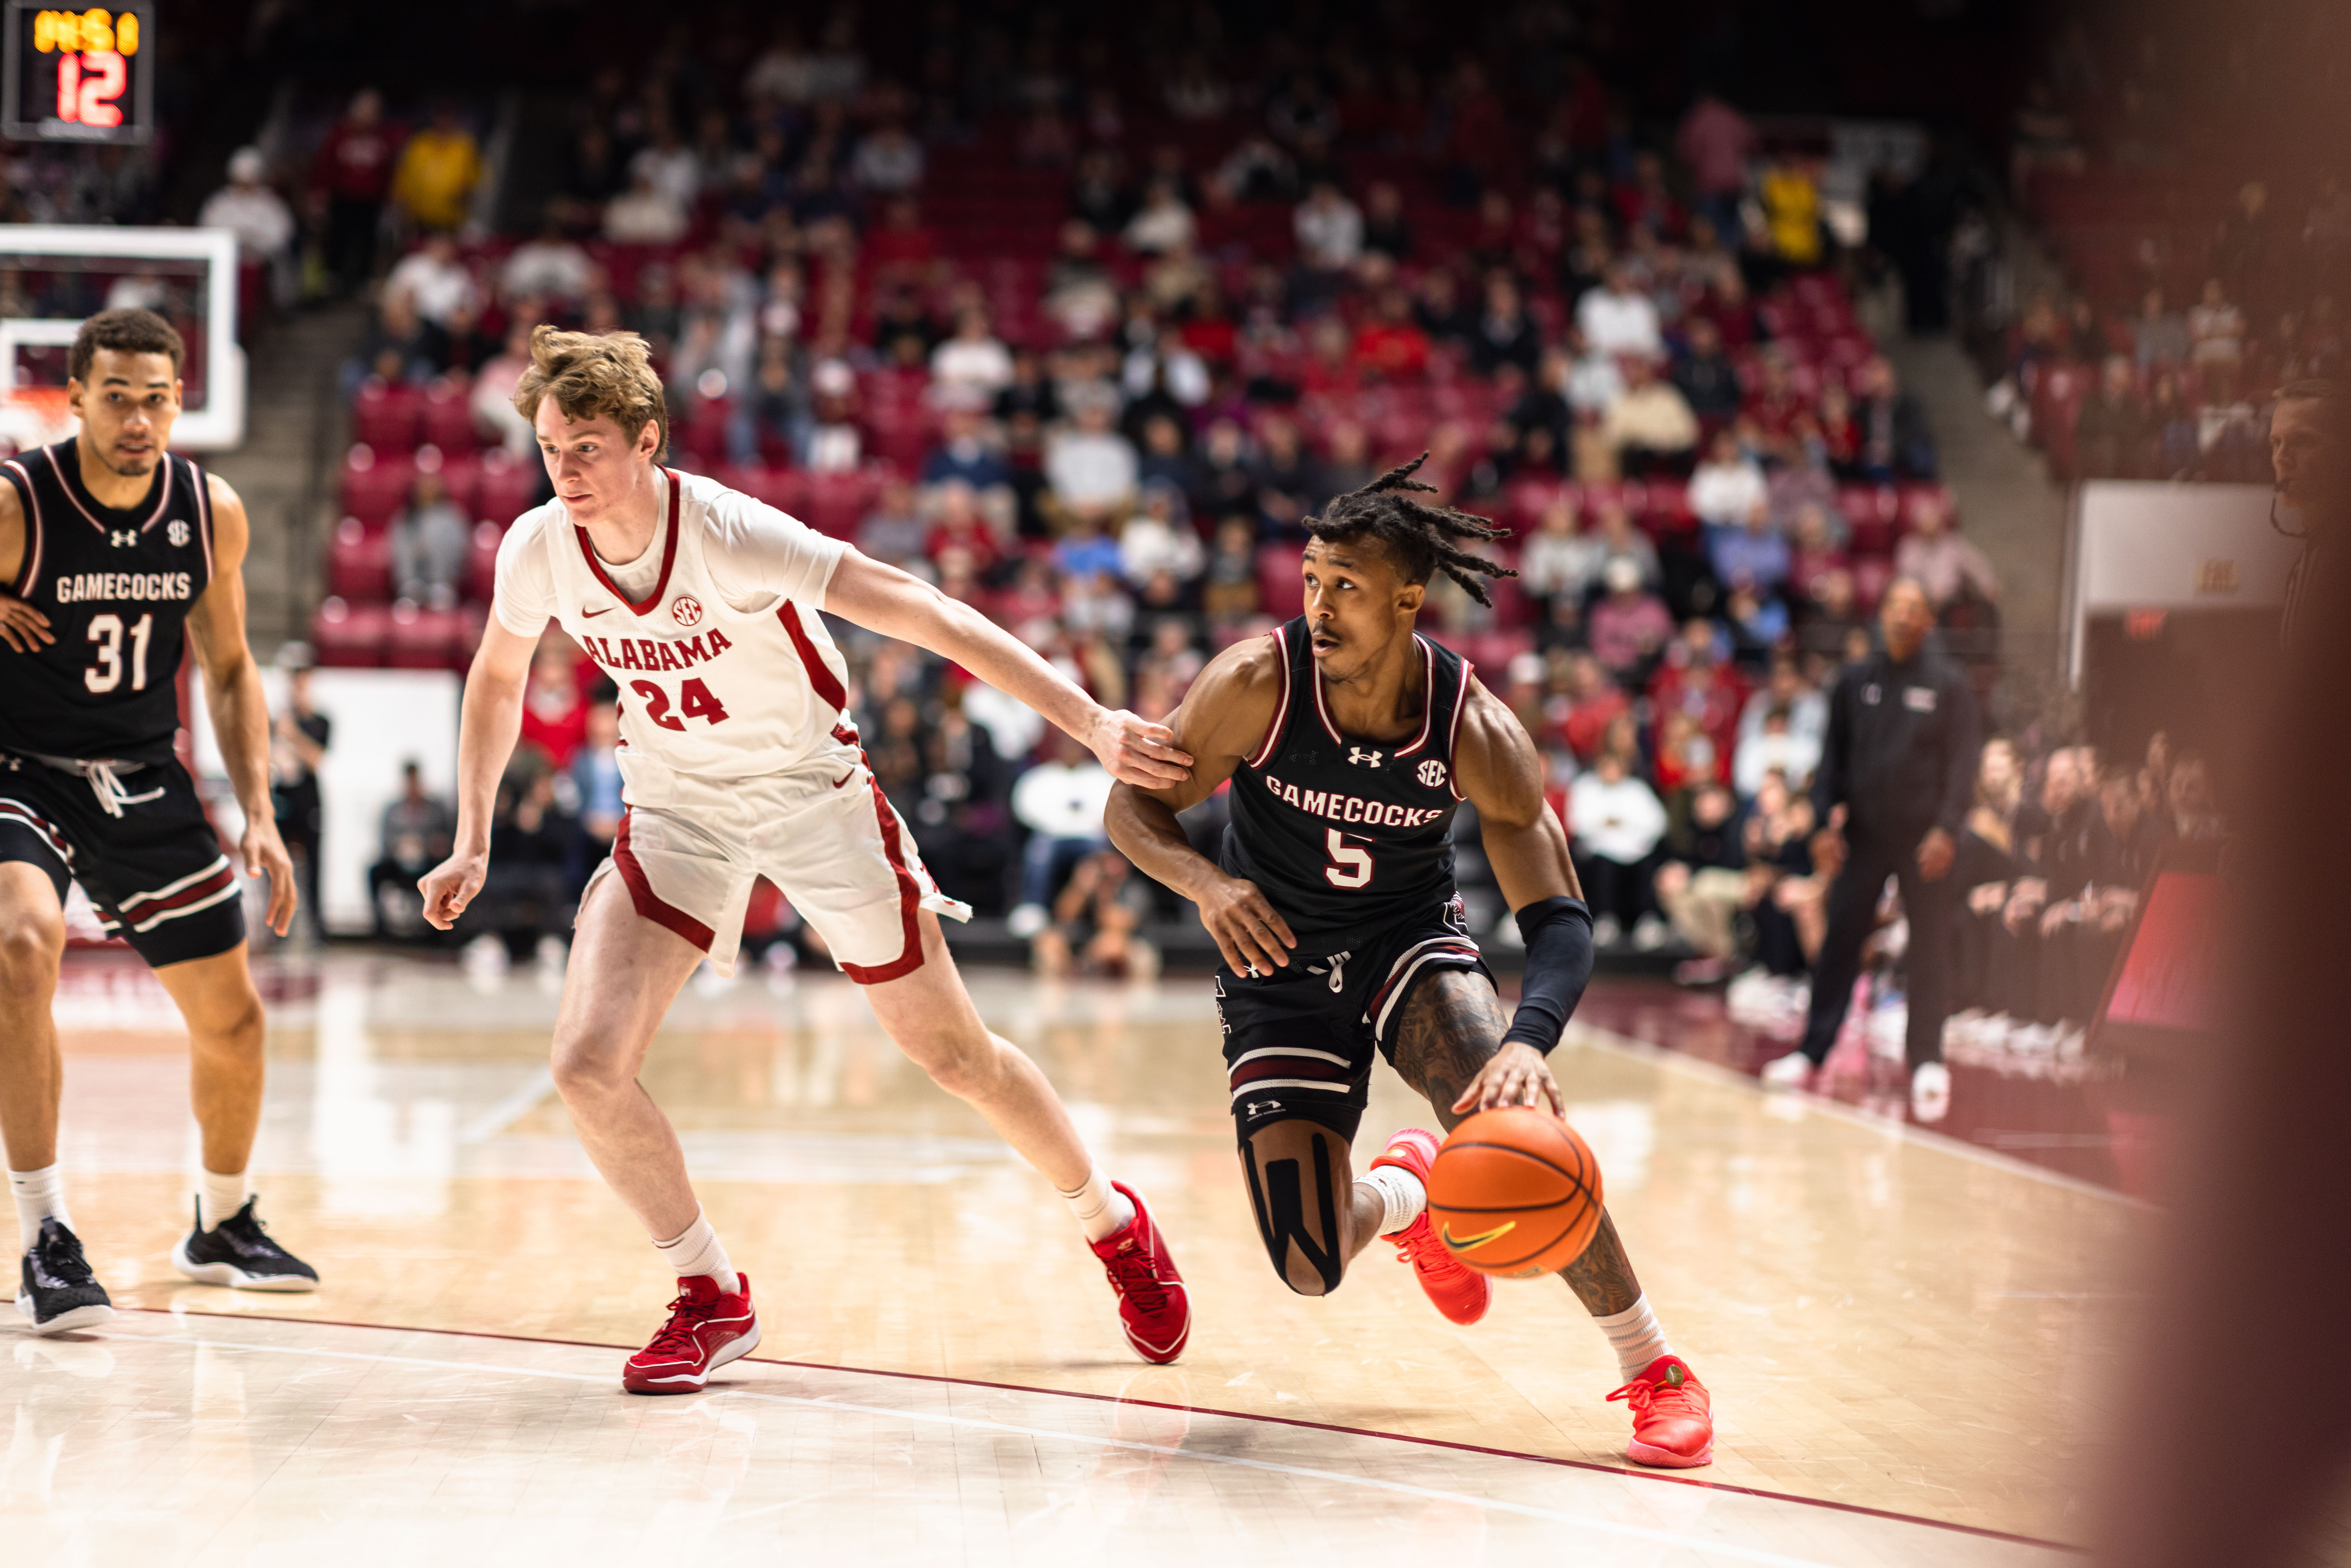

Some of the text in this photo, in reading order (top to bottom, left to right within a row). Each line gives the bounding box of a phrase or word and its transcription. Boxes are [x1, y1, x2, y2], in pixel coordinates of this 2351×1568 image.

[57, 50, 126, 127] 12
[167, 519, 191, 547] SEC
[56, 572, 191, 604] GAMECOCKS
[673, 596, 702, 626] SEC
[85, 613, 153, 695] 31
[582, 628, 732, 671] ALABAMA
[630, 678, 730, 732] 24
[1417, 759, 1447, 787] SEC
[1266, 775, 1444, 827] GAMECOCKS
[1324, 827, 1376, 890] 5
